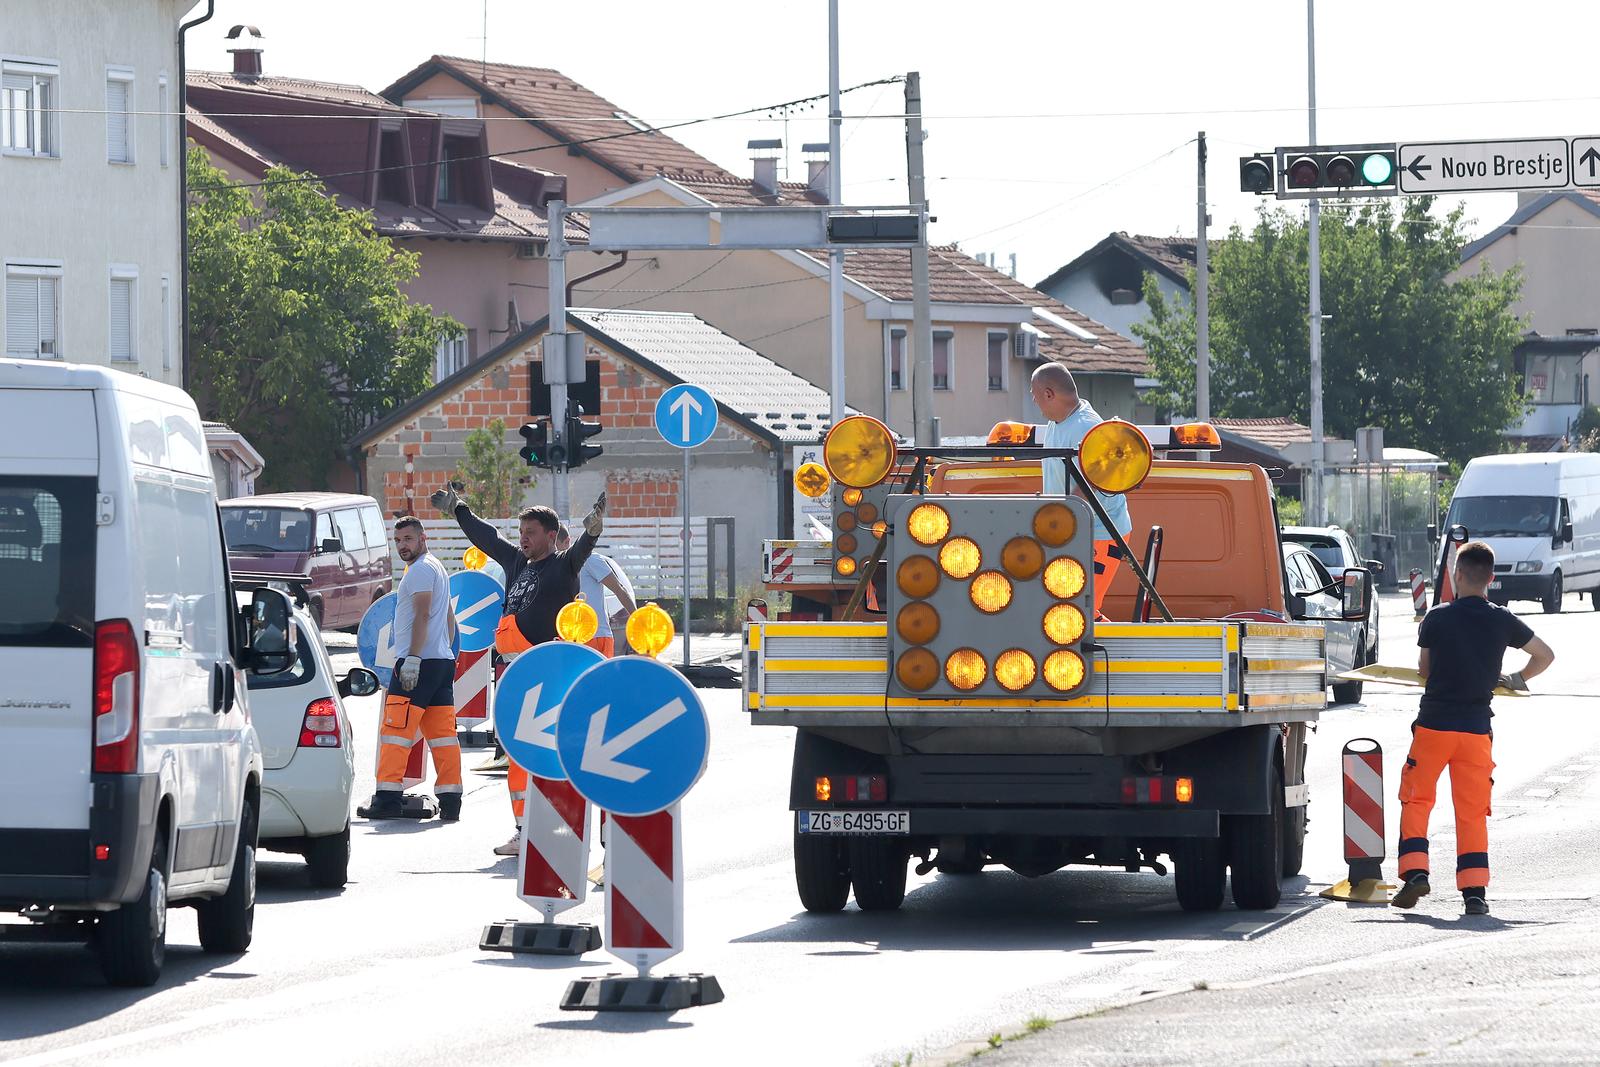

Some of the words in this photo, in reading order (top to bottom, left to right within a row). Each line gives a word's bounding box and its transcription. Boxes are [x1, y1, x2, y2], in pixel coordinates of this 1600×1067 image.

[1441, 157, 1487, 178] Novo
[1493, 153, 1563, 180] Brestje
[811, 813, 832, 831] ZG
